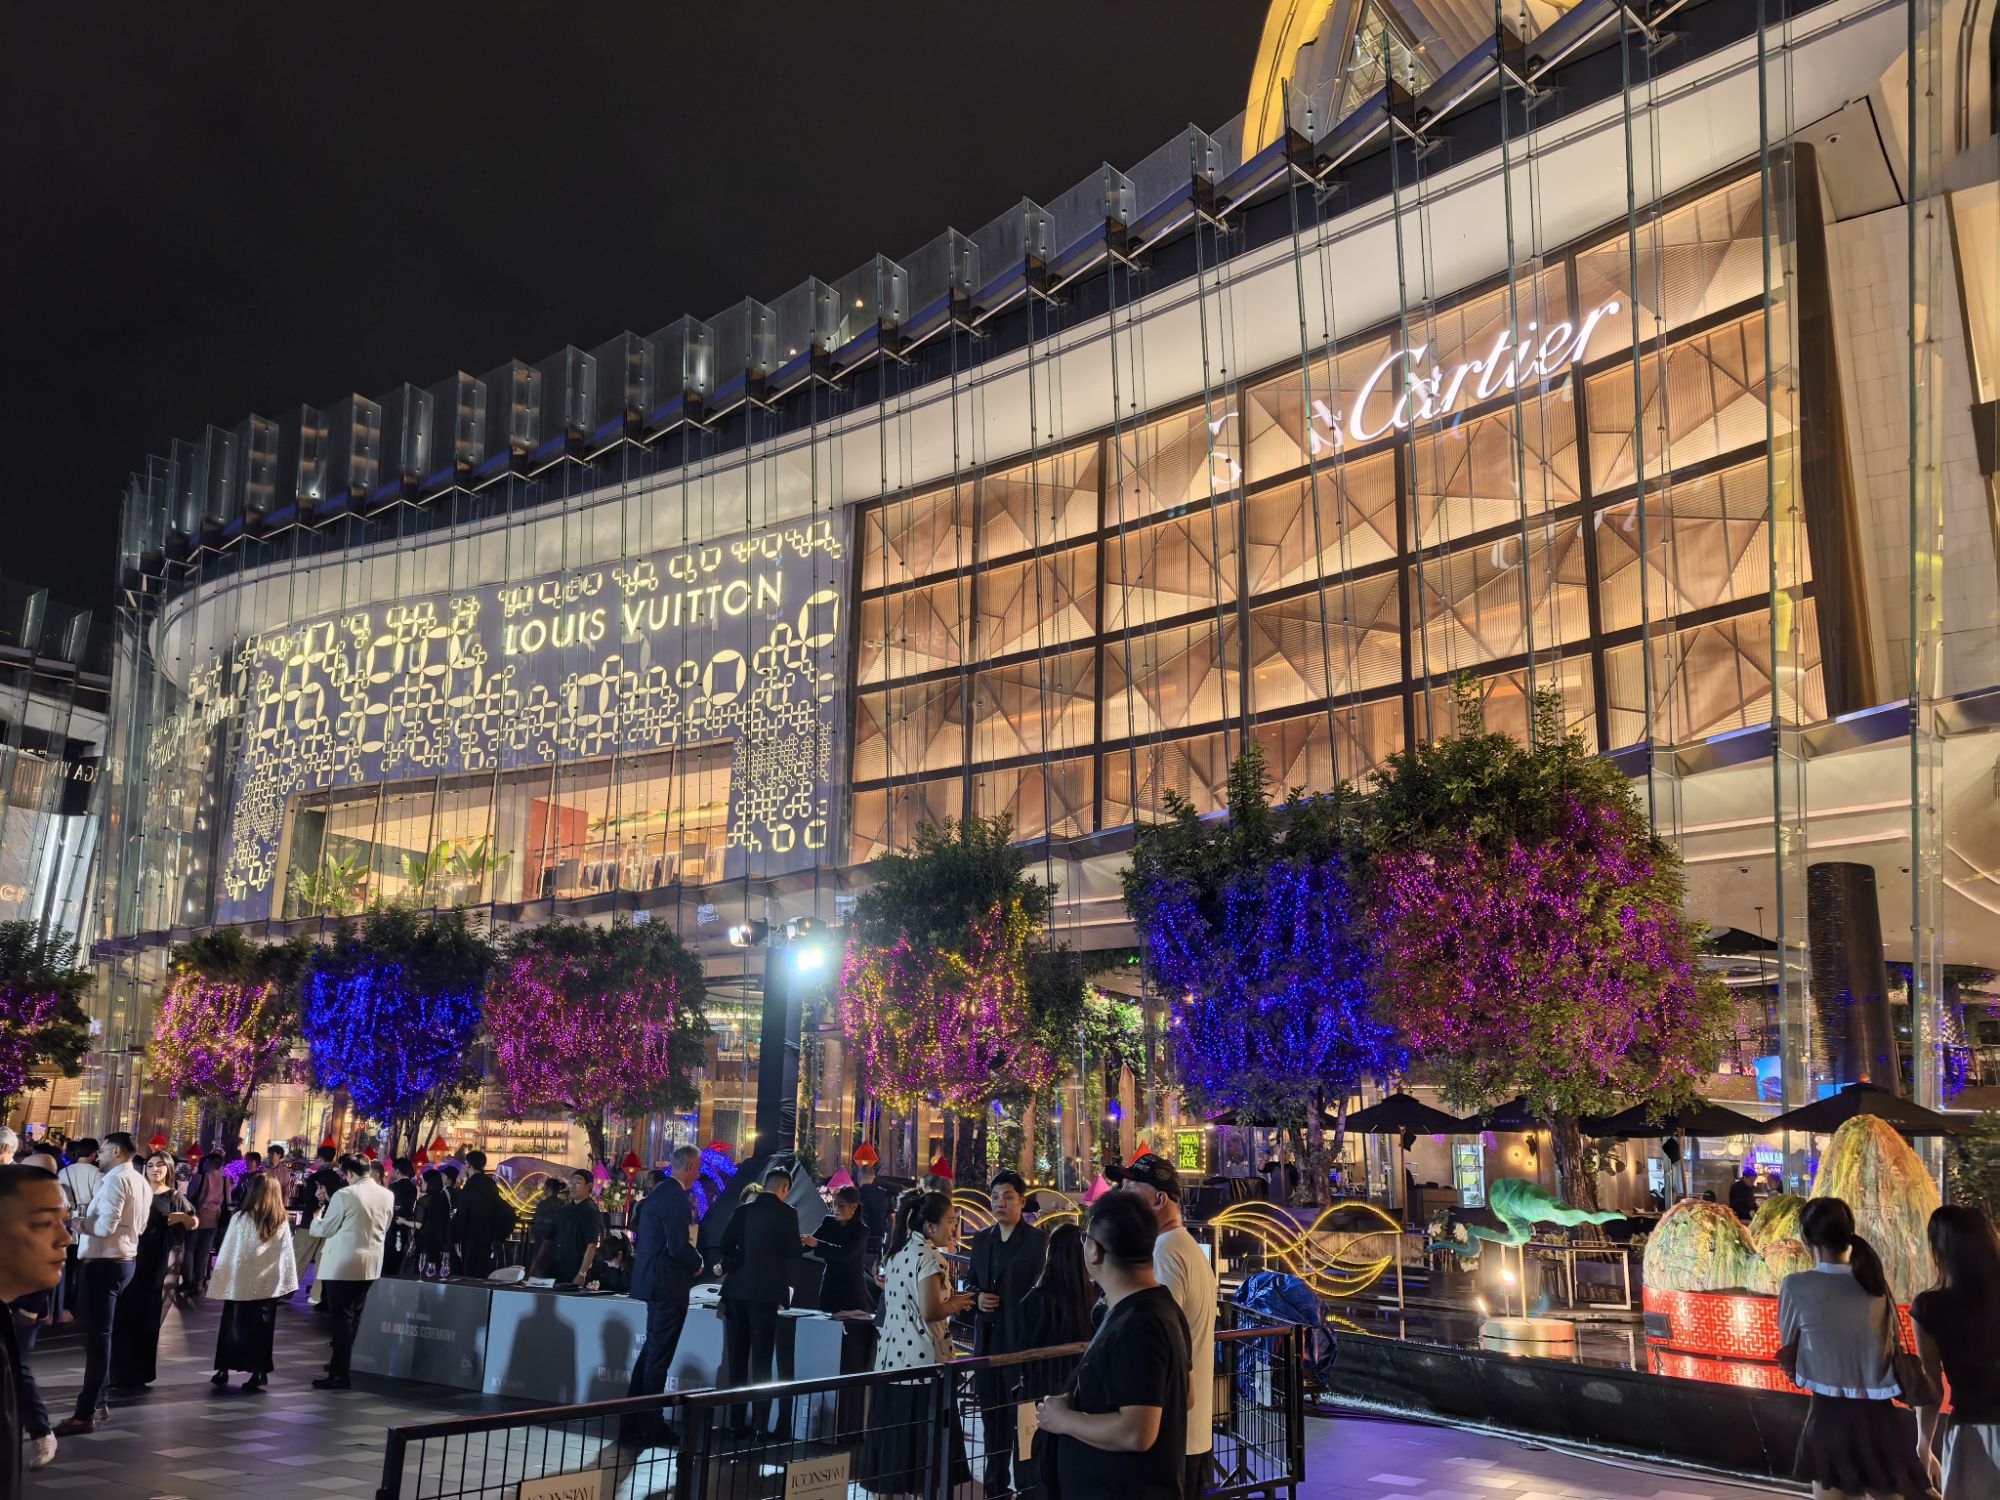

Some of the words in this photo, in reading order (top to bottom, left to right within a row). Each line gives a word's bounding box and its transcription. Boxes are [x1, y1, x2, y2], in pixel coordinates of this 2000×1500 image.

[1350, 301, 1620, 441] Cartier
[504, 608, 606, 655] LOUIS
[622, 571, 783, 637] VUITTON
[1180, 1154, 1197, 1168] HOUSE
